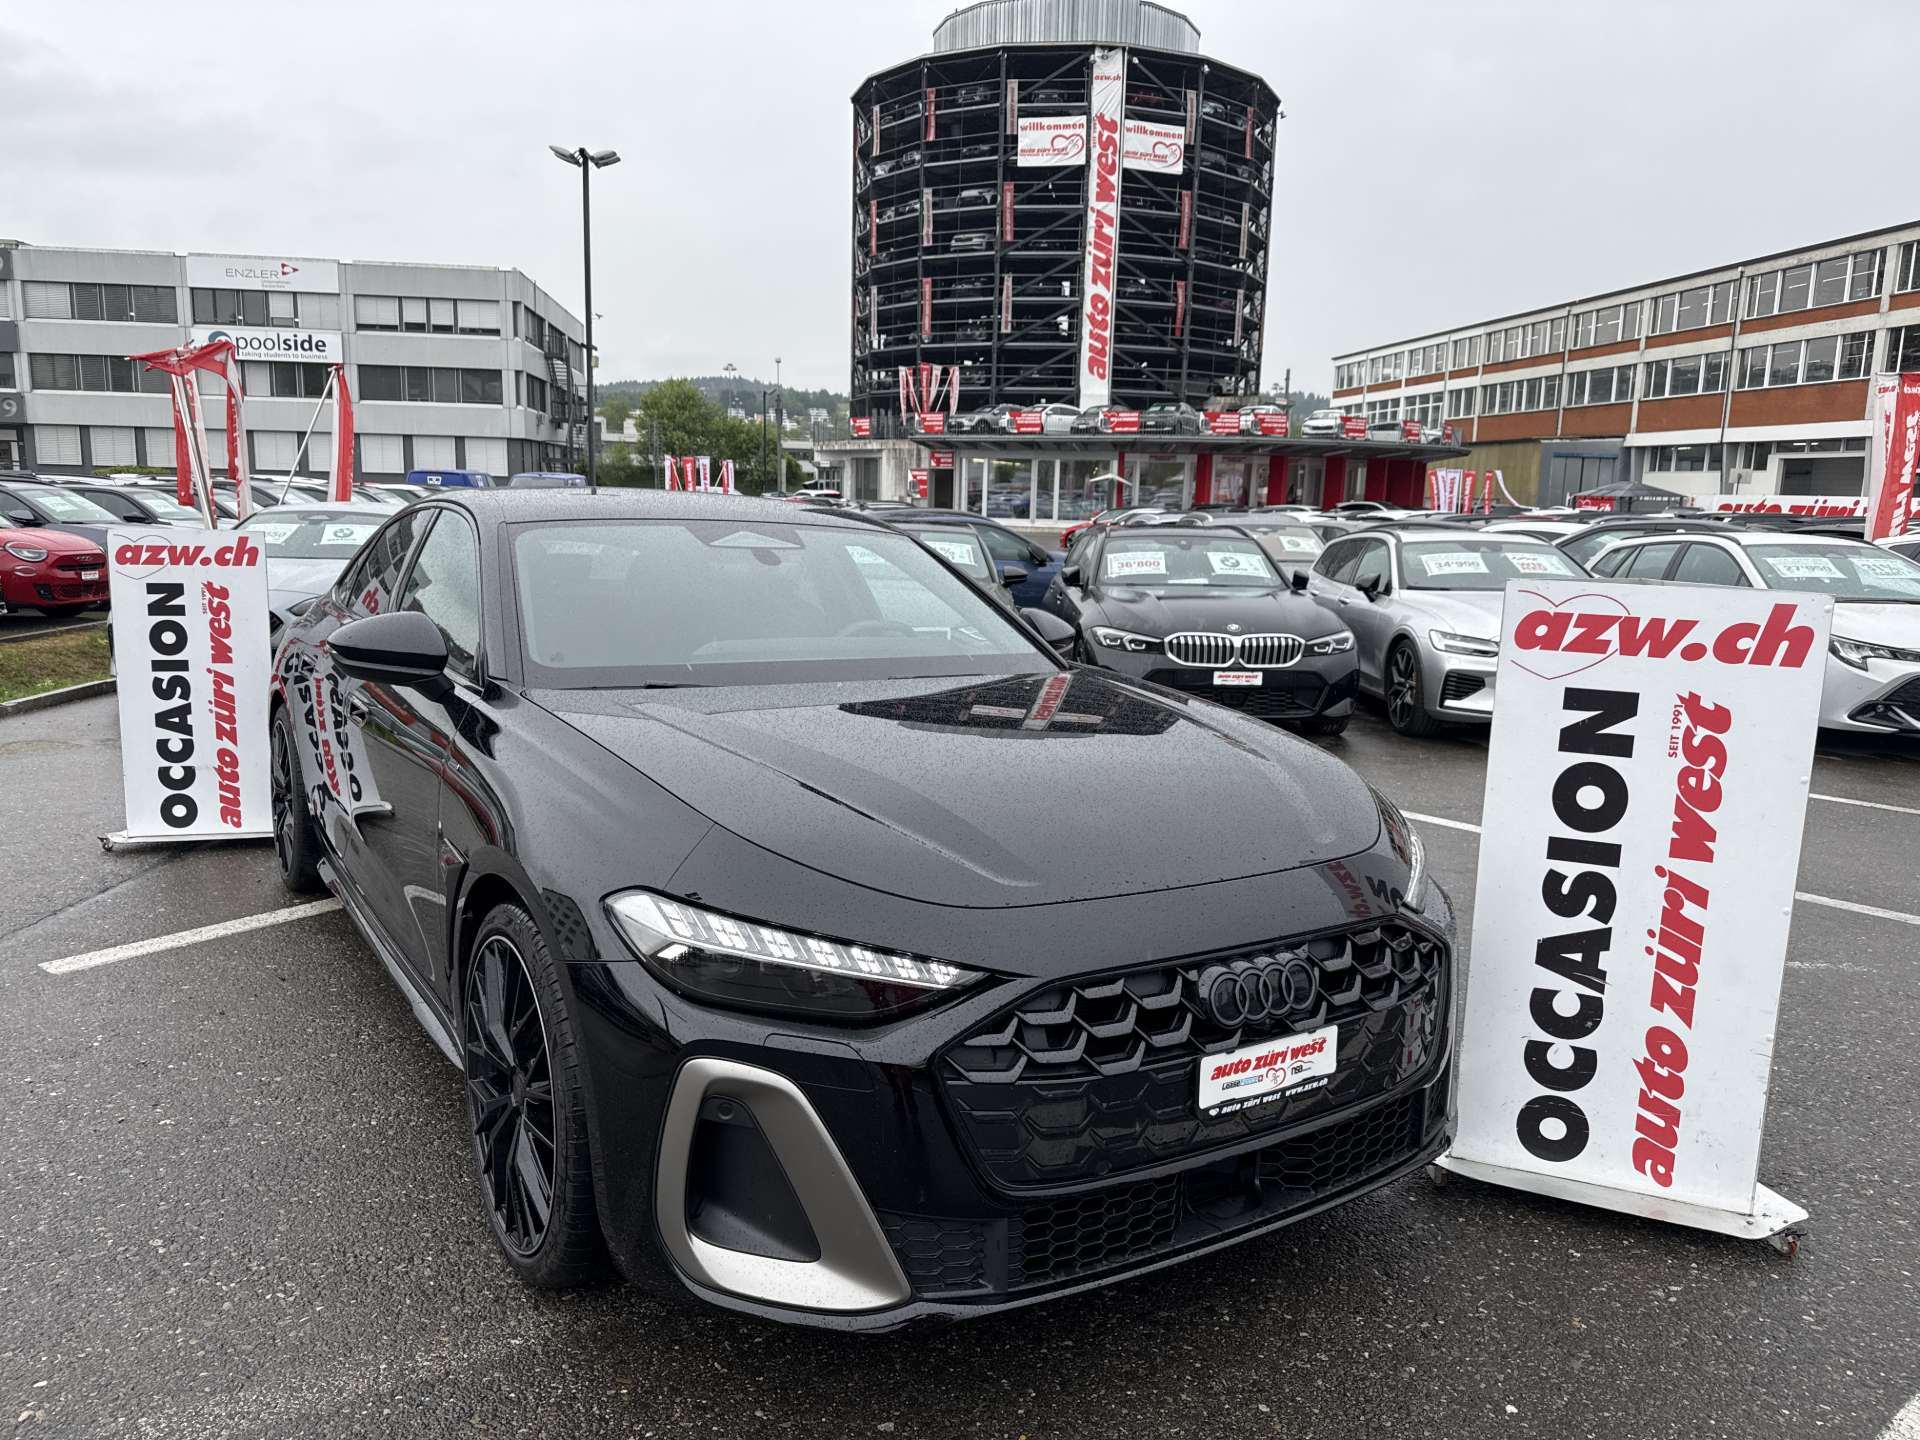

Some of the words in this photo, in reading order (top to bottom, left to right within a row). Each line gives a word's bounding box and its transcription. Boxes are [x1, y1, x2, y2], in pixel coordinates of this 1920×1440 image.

[1020, 122, 1084, 131] willkommen
[1095, 112, 1118, 203] west
[1125, 124, 1183, 139] willkommen
[225, 268, 279, 279] ENZLER
[1088, 207, 1115, 292] züri
[235, 333, 327, 356] poolside
[242, 351, 262, 359] taking
[263, 351, 292, 359] students
[1086, 293, 1110, 381] auto
[115, 537, 259, 567] azw.ch
[201, 580, 234, 664] west
[1514, 604, 1814, 669] azw.ch
[146, 583, 199, 828] OCCASION
[206, 667, 238, 747] züri
[1672, 704, 1683, 731] 1991
[1668, 691, 1732, 864] west
[1669, 736, 1680, 758] SEIT
[214, 747, 242, 829] auto
[1516, 686, 1641, 1163] OCCASION
[1643, 864, 1717, 1030] züri
[1211, 1058, 1252, 1081] auto
[1252, 1046, 1289, 1071] züri
[1290, 1039, 1327, 1061] west
[1221, 1103, 1241, 1114] auto
[1263, 1092, 1281, 1103] west
[1285, 1078, 1329, 1097] www.azw.ch
[1631, 1025, 1689, 1187] auto
